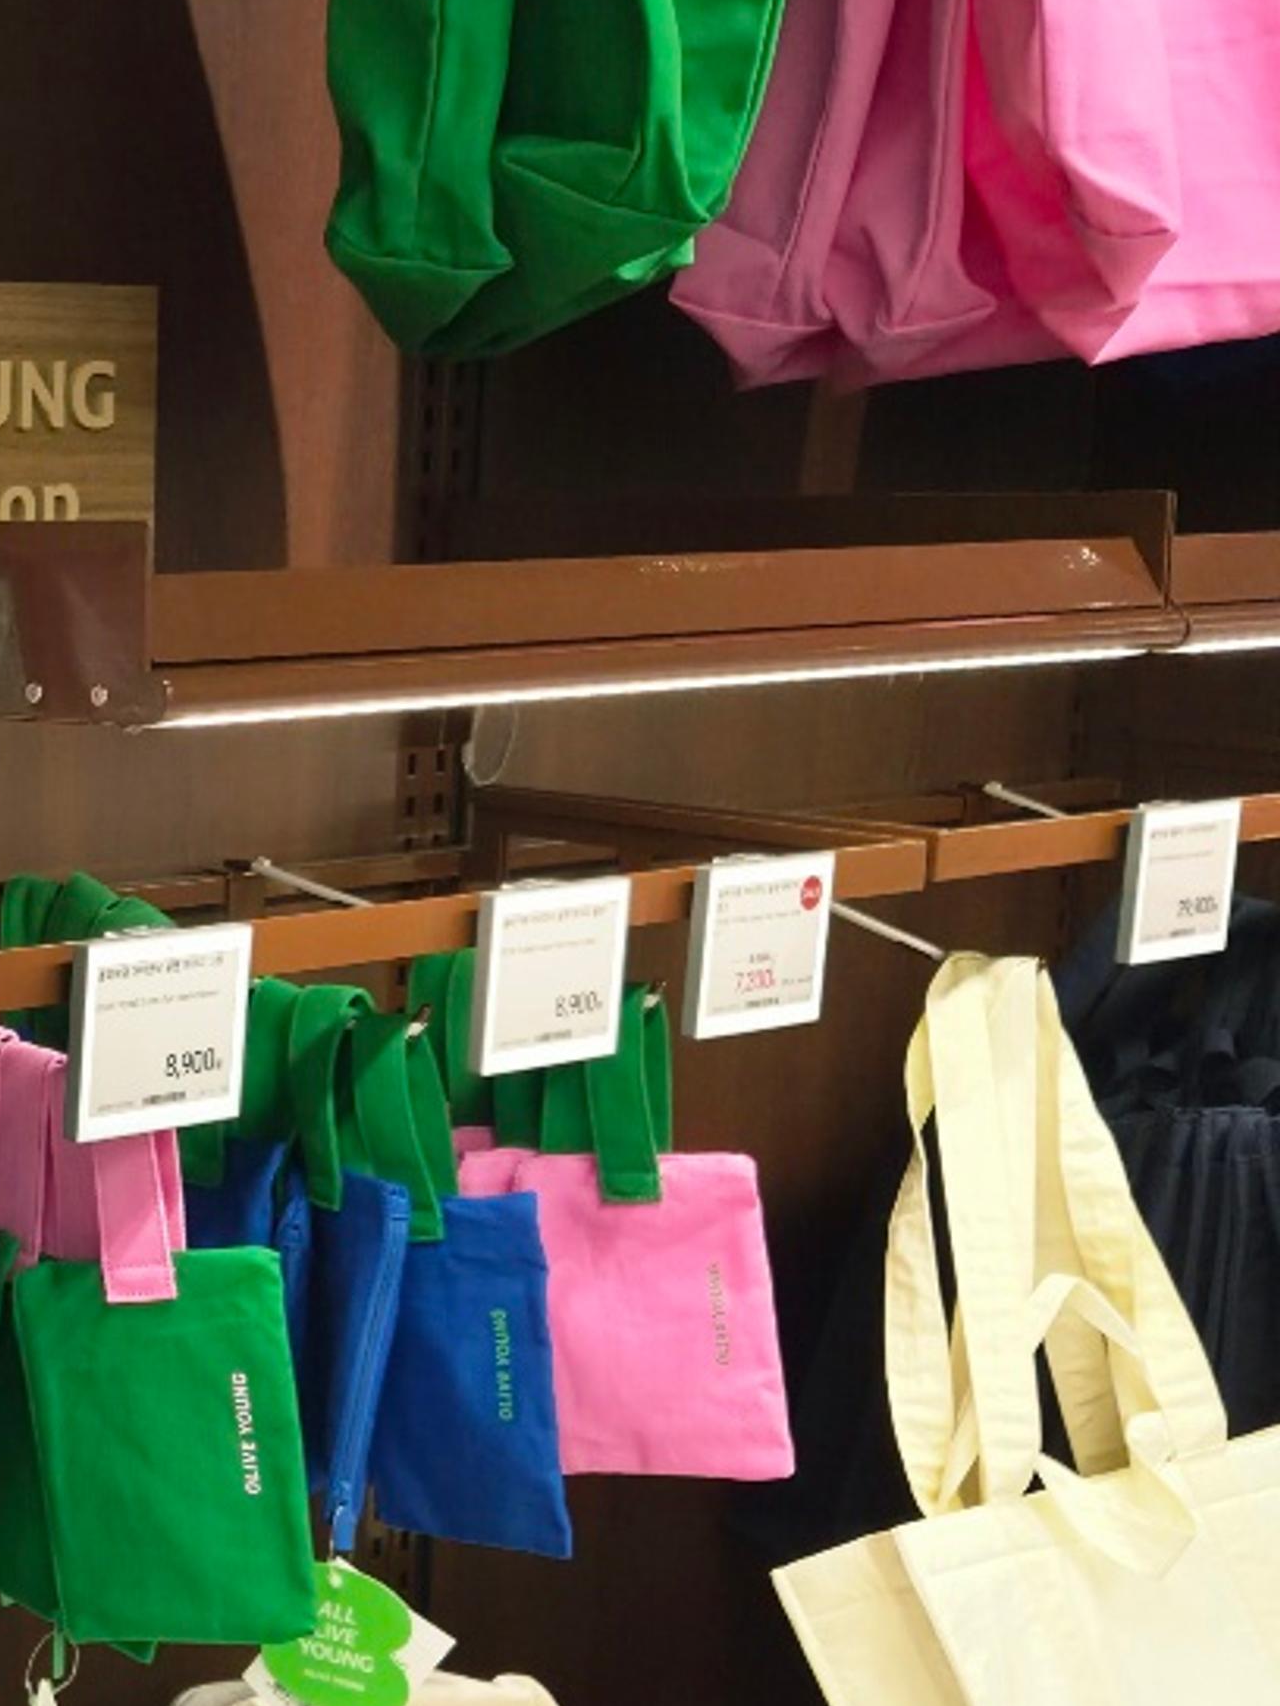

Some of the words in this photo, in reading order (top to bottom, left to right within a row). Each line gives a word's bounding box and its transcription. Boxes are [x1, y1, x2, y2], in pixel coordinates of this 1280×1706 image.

[231, 1371, 253, 1434] YOUNG
[241, 1440, 262, 1495] OLIVE
[299, 1637, 374, 1674] YOUNG
